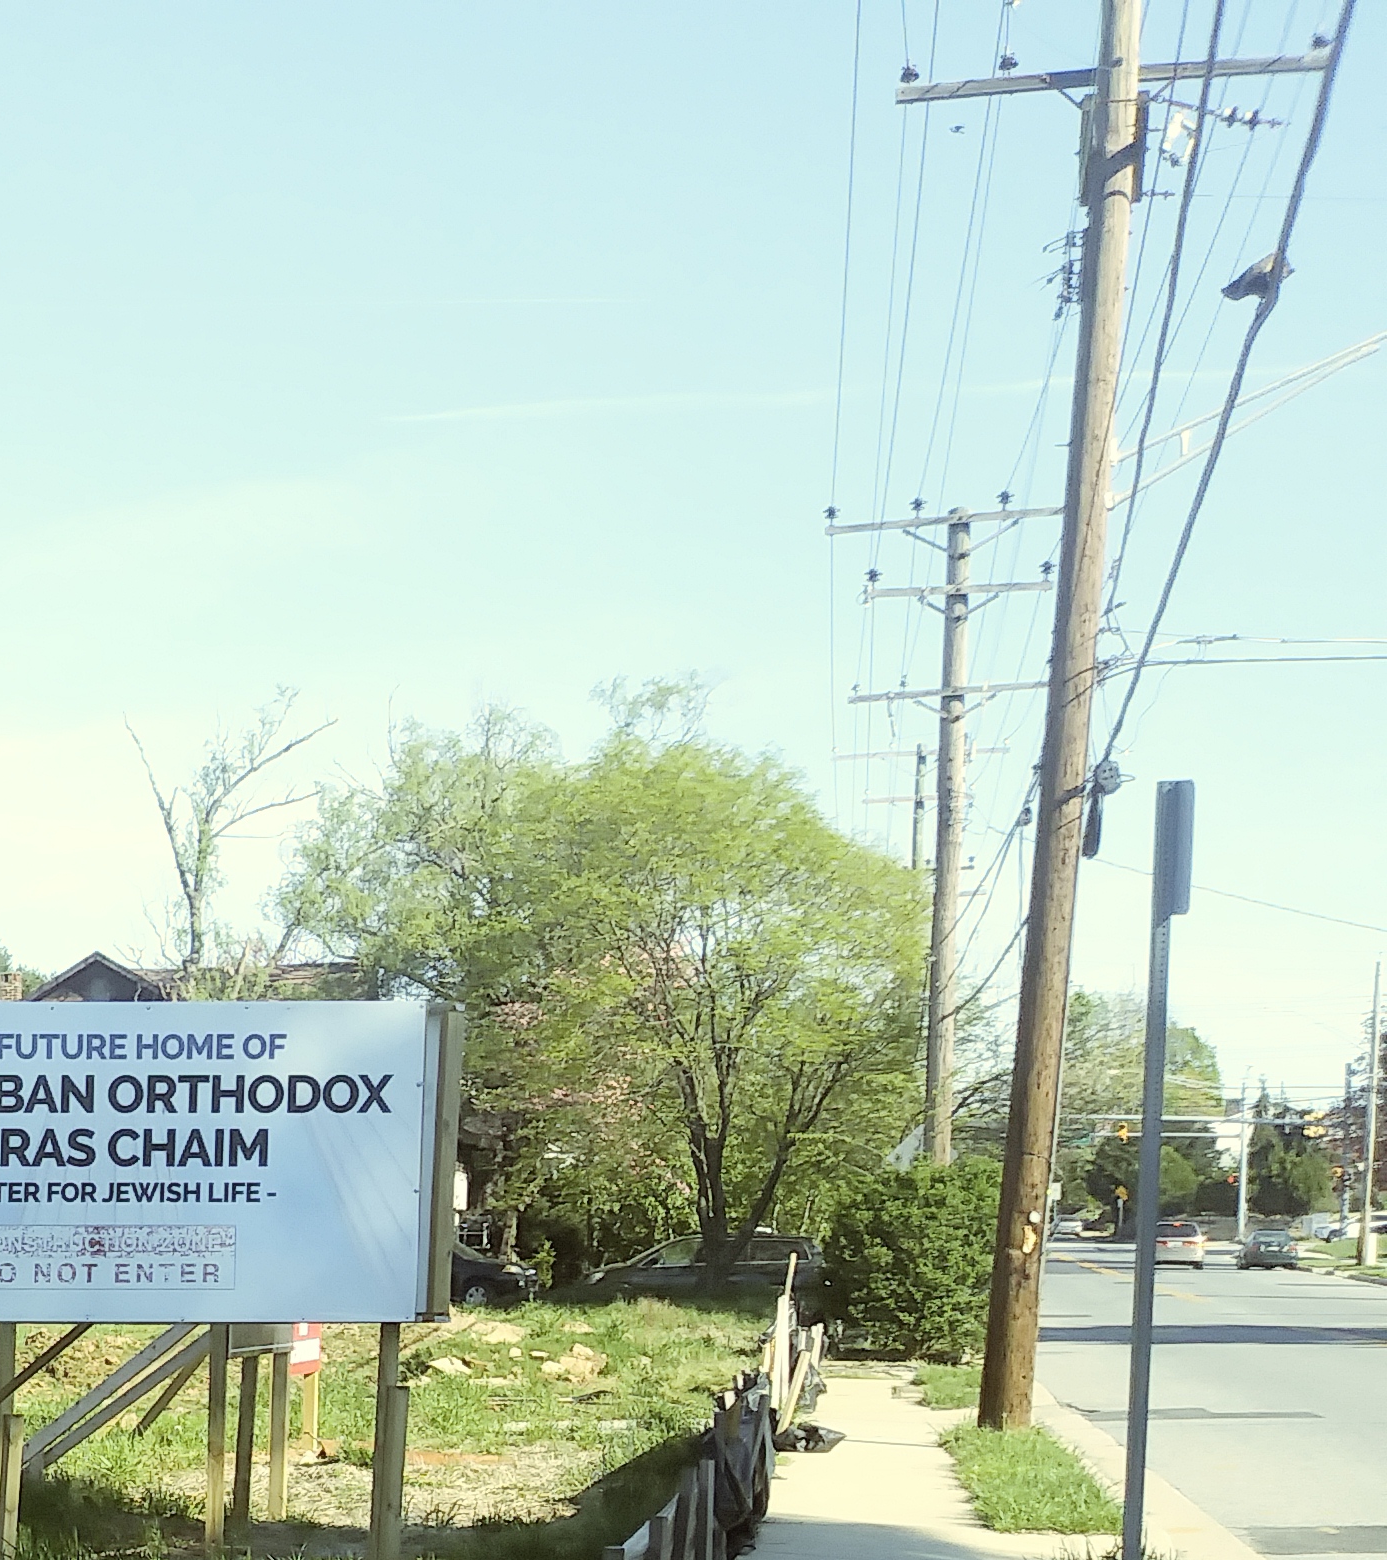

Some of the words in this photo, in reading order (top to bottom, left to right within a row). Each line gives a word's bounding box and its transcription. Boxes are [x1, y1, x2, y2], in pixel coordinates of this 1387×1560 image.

[136, 1033, 235, 1061] HOME
[242, 1033, 288, 1060] OF
[107, 1074, 395, 1114] ORTHODOX
[107, 1128, 269, 1168] CHAIM
[46, 1182, 98, 1203] FOR
[101, 1181, 201, 1203] JEWISH
[207, 1182, 261, 1203] LIFE
[33, 1262, 100, 1284] NOT
[114, 1262, 221, 1284] ENTER
